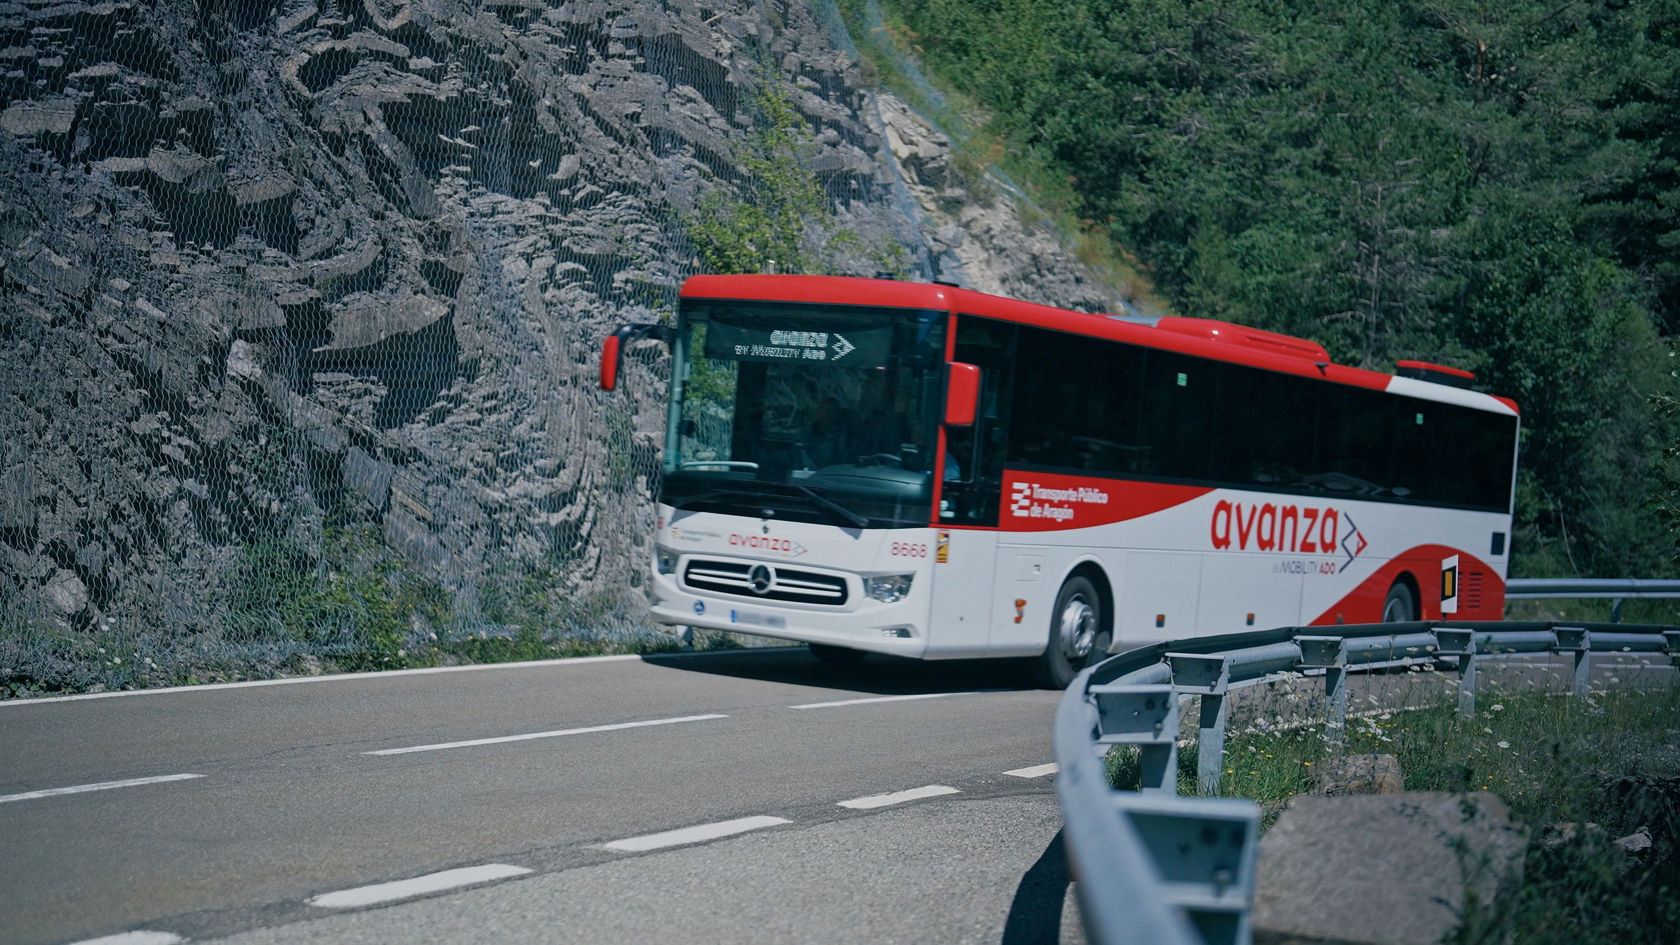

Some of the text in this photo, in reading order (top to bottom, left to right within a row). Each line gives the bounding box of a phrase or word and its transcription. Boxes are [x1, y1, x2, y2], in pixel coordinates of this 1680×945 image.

[770, 329, 828, 348] avanza
[734, 344, 749, 355] BY
[751, 344, 800, 359] MOBILITY
[1031, 483, 1109, 504] Transporte Público
[1030, 502, 1074, 522] de Aragón
[1210, 499, 1339, 554] avanza
[728, 533, 791, 552] avanza
[891, 541, 928, 558] 8668
[1319, 561, 1336, 575] ADO
